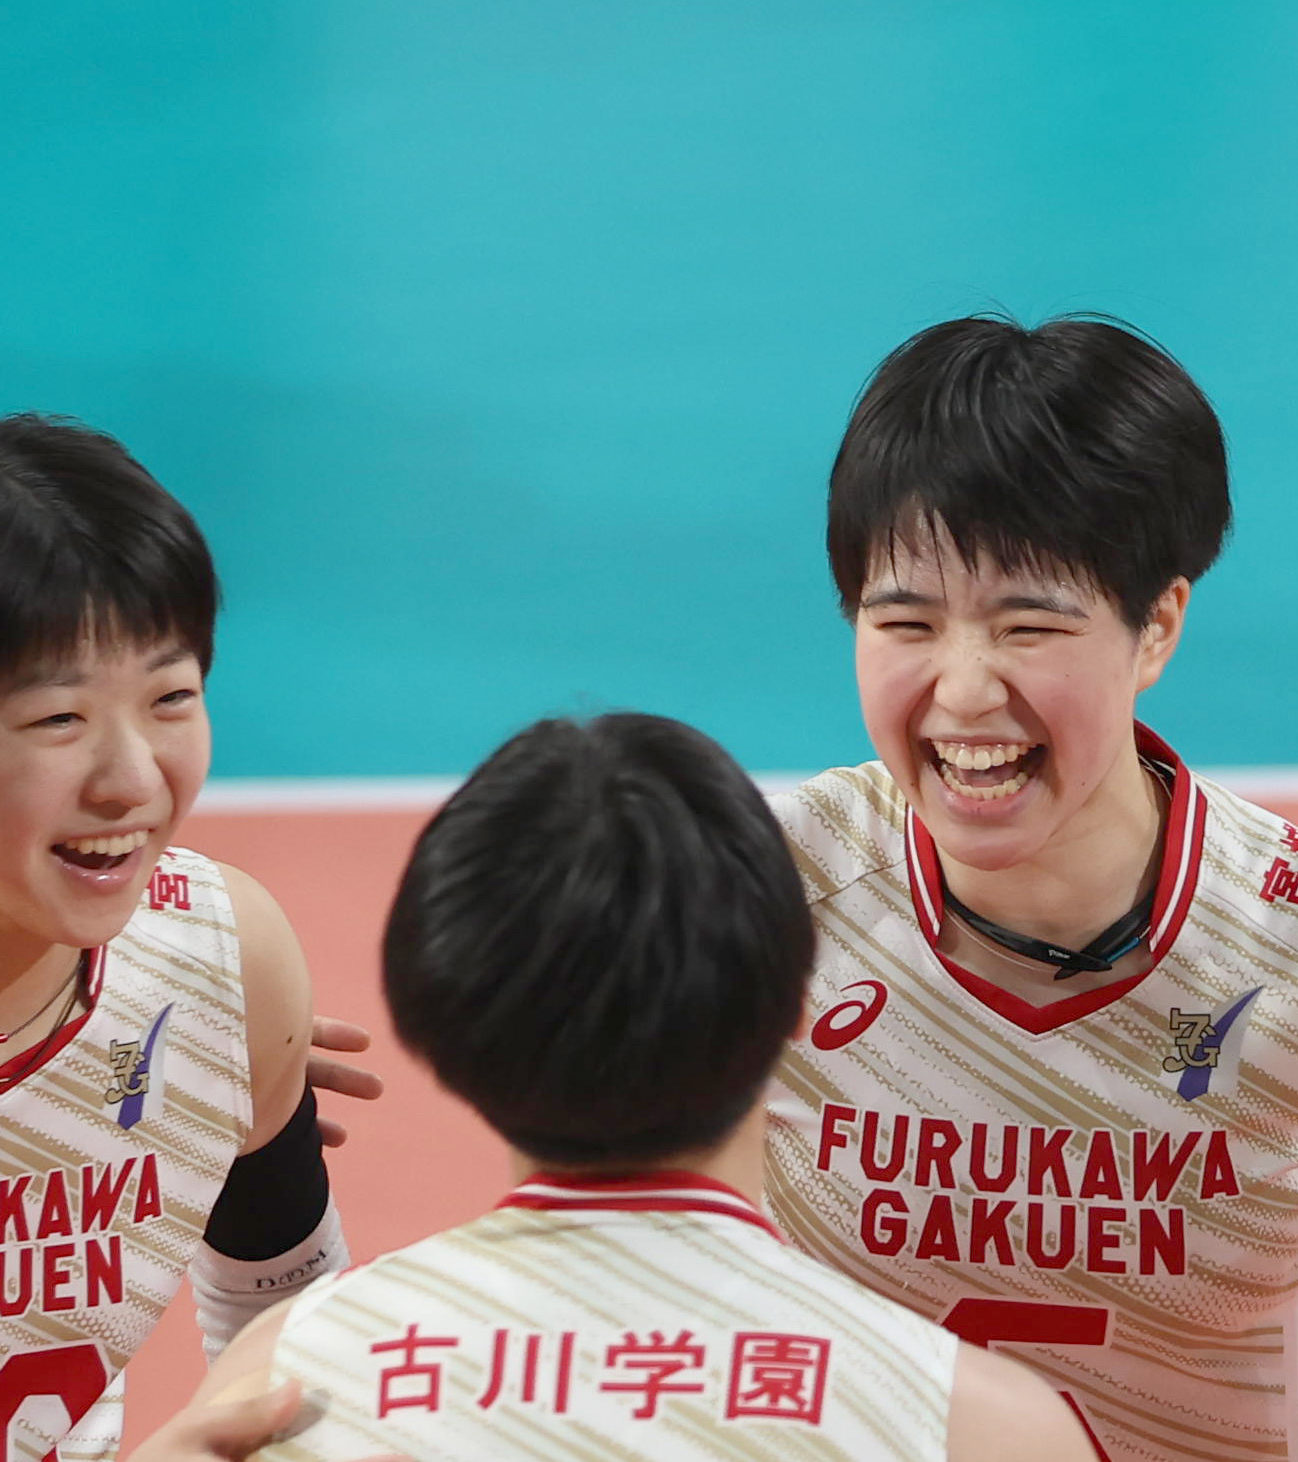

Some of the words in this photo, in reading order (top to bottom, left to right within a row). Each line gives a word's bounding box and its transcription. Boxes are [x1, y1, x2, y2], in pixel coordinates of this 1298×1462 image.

[817, 1103, 1241, 1202] FURUKAWA
[859, 1188, 1187, 1277] GAKUEN
[369, 1324, 832, 1426] 古川学園
